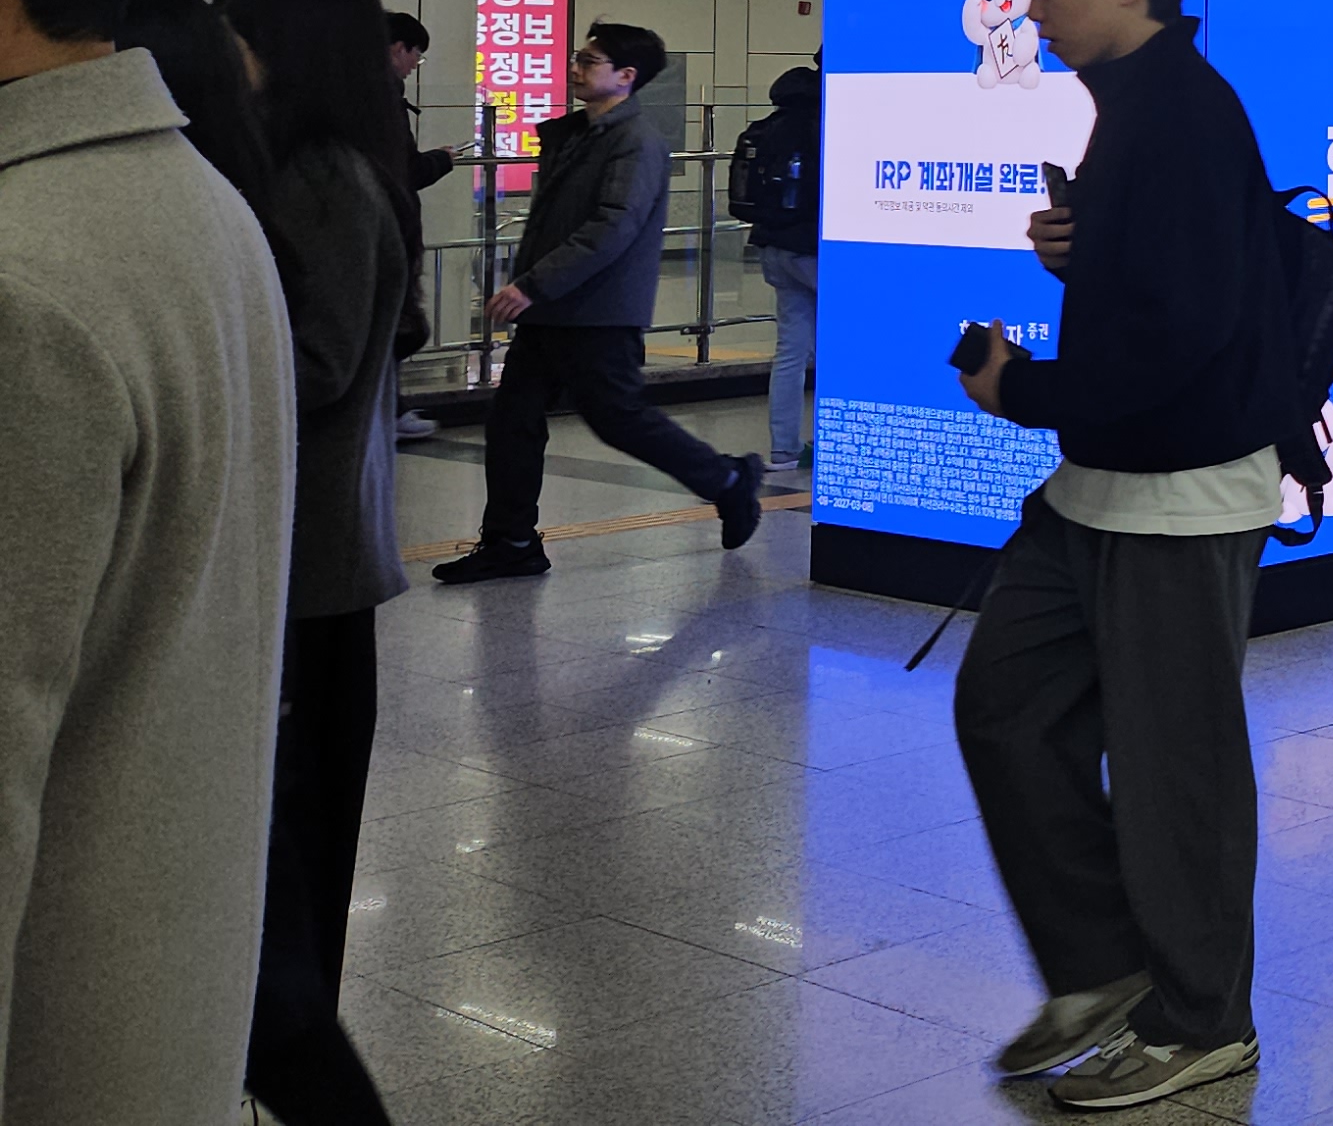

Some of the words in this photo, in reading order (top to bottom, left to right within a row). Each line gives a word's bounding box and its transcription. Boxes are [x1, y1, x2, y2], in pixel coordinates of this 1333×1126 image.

[875, 160, 912, 191] IRP
[917, 161, 994, 193] 계좌개설
[999, 161, 1047, 195] 완료!
[1027, 322, 1049, 341] 증권
